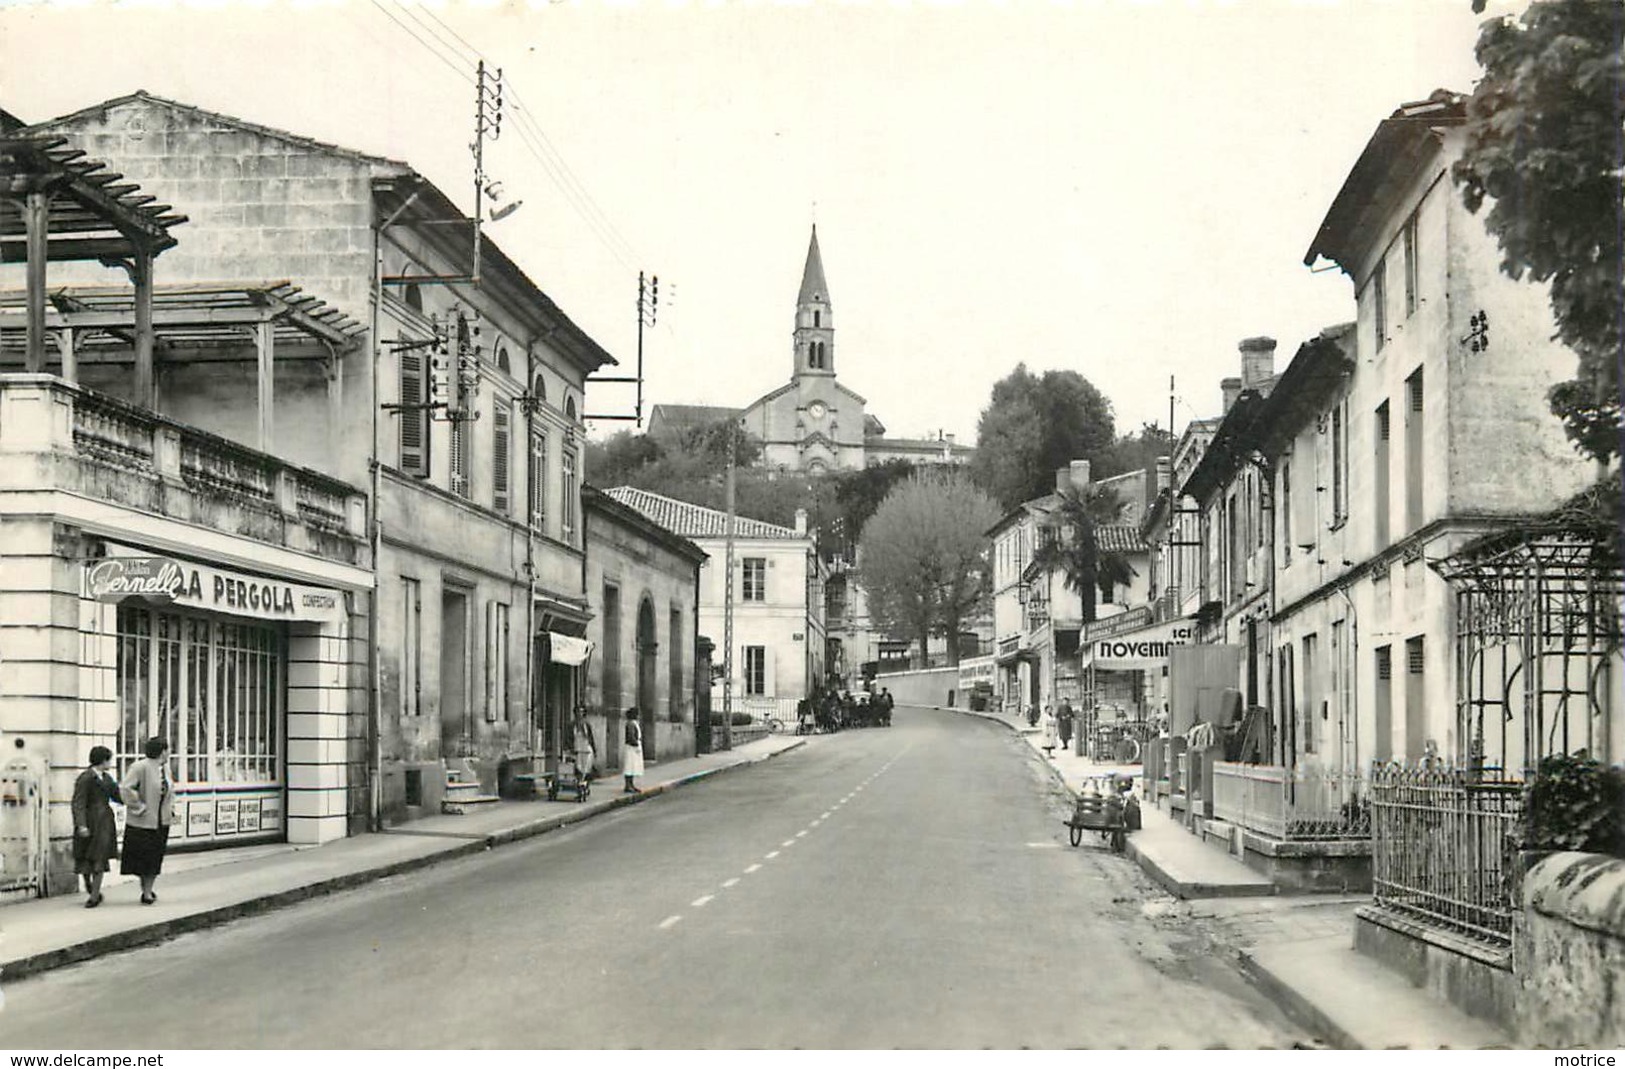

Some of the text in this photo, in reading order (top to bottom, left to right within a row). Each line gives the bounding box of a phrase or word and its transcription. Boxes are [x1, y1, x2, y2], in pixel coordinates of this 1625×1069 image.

[213, 575, 295, 614] PERGOLA
[1173, 628, 1191, 638] ICI
[1101, 641, 1185, 657] NOVEM
